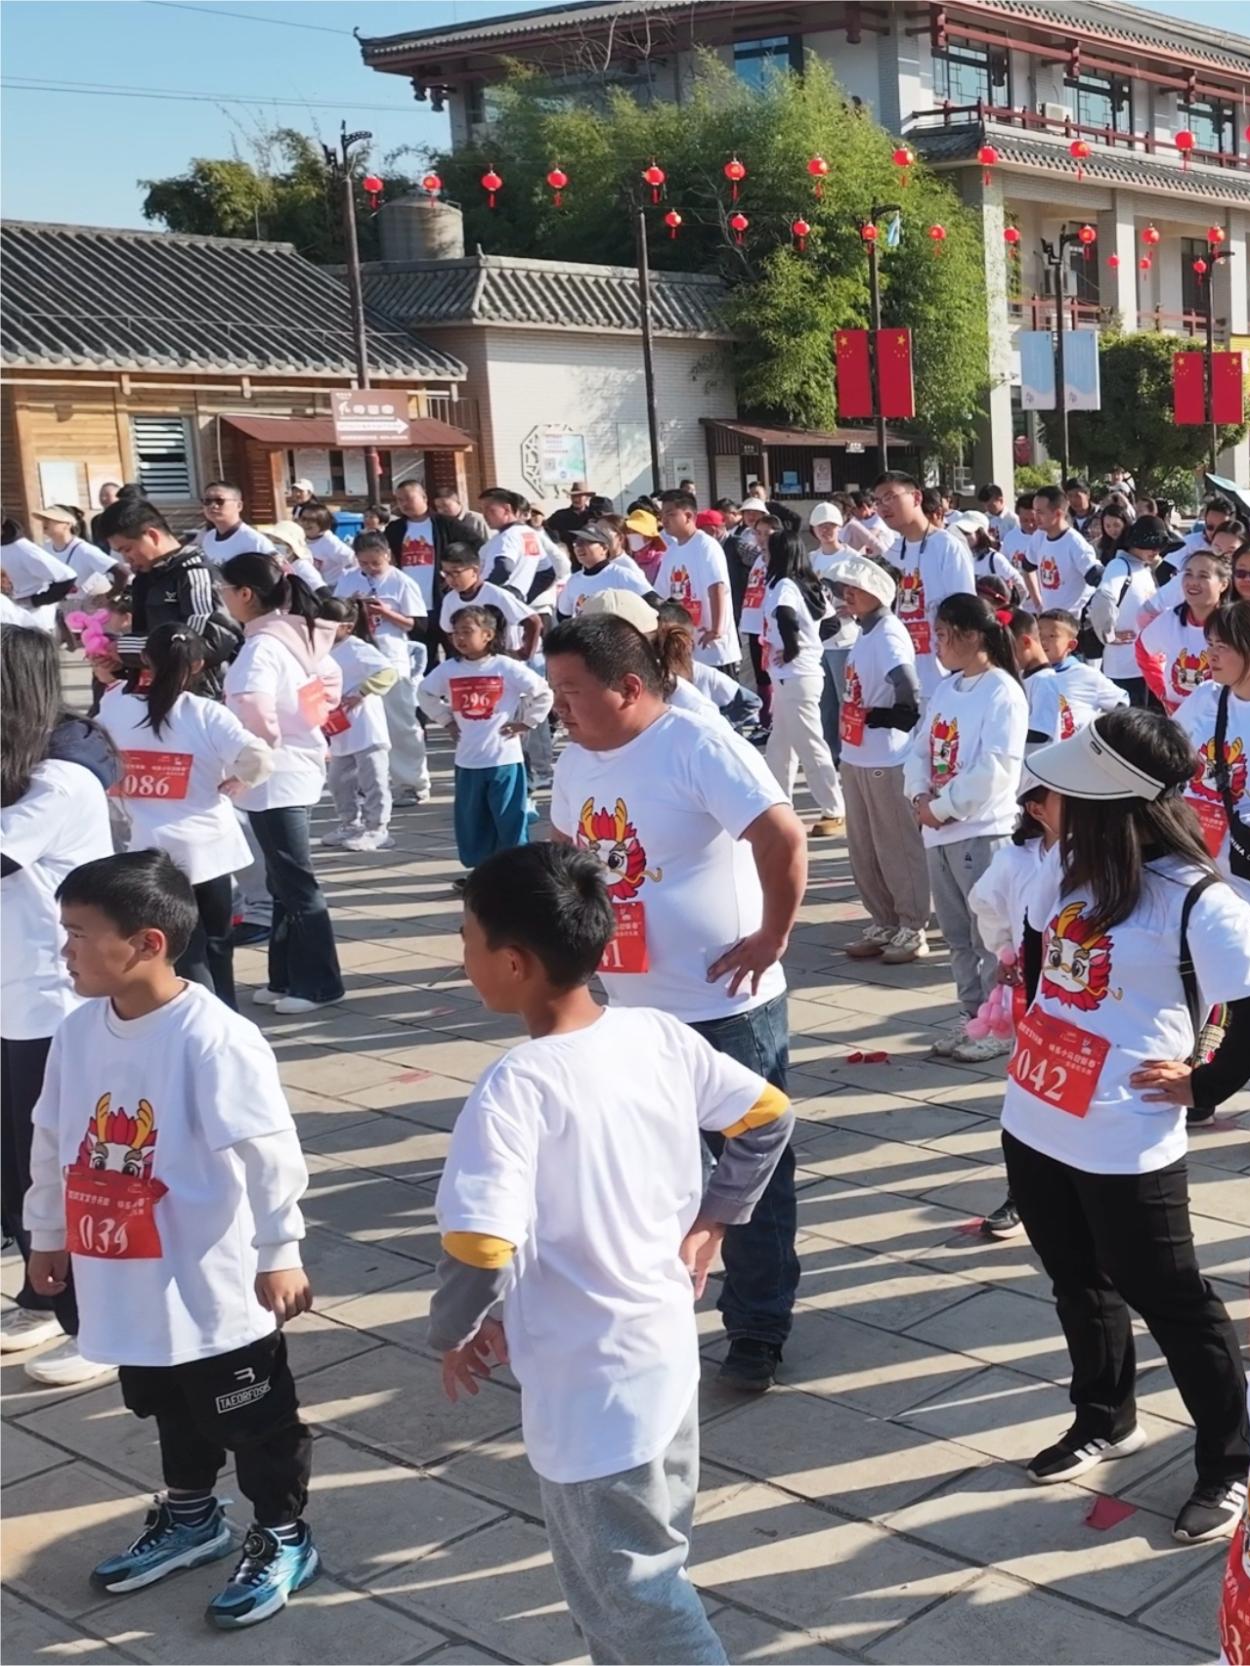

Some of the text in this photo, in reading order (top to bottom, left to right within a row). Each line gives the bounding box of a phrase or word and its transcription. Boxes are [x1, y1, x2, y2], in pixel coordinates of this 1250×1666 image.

[461, 692, 491, 709] 296
[124, 774, 170, 797] 086
[1016, 1048, 1069, 1102] 042
[79, 1214, 129, 1256] 034
